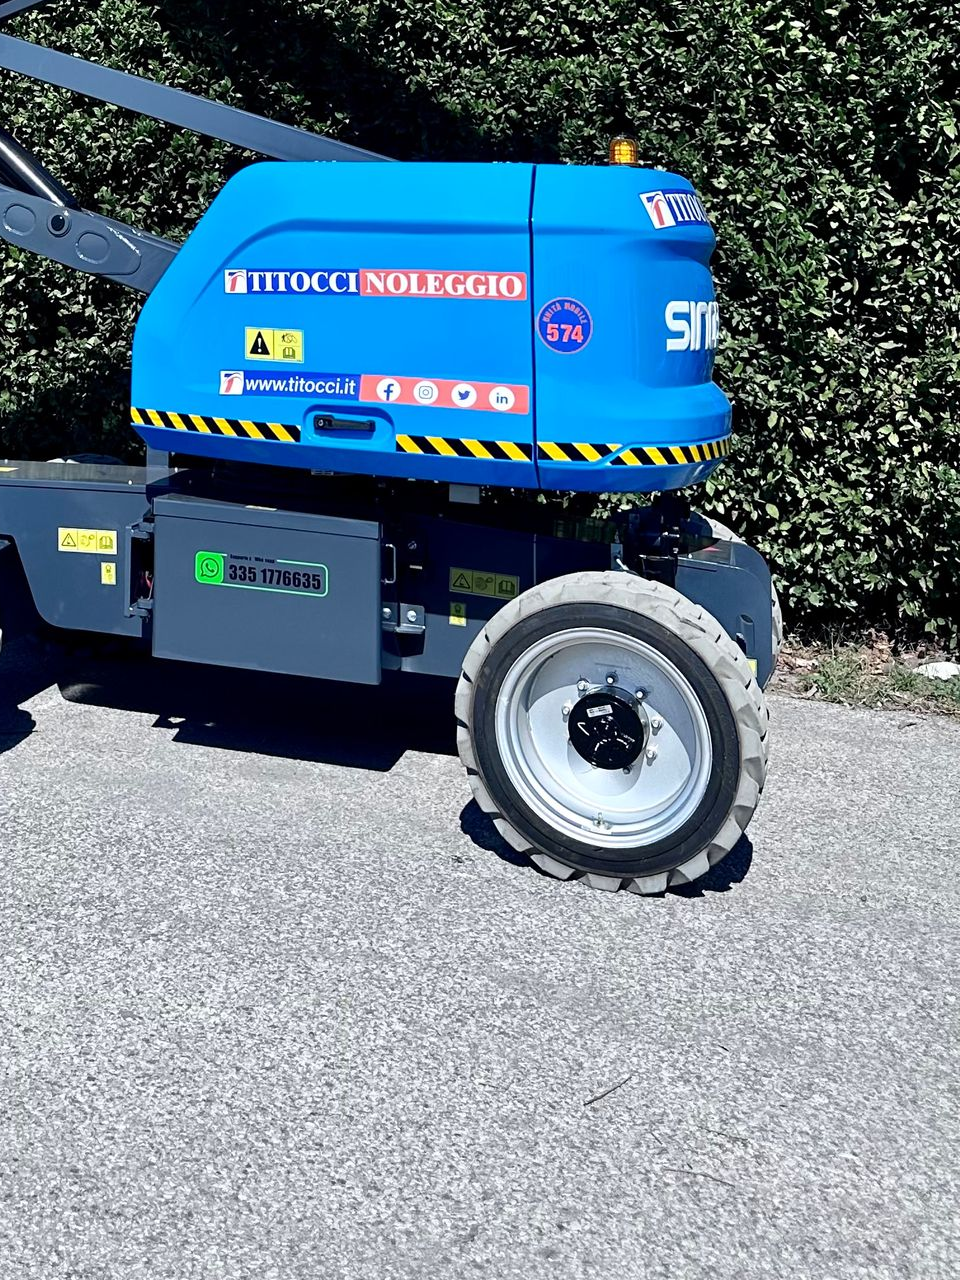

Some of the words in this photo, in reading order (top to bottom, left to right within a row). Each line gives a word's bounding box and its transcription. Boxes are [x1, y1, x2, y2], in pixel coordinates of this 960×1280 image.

[248, 271, 359, 293] TITOCCI
[364, 271, 523, 298] NOLEGGIO
[546, 323, 584, 343] 574
[245, 375, 357, 396] www.titocci.it
[228, 564, 257, 583] 335
[260, 568, 321, 590] 1776635
